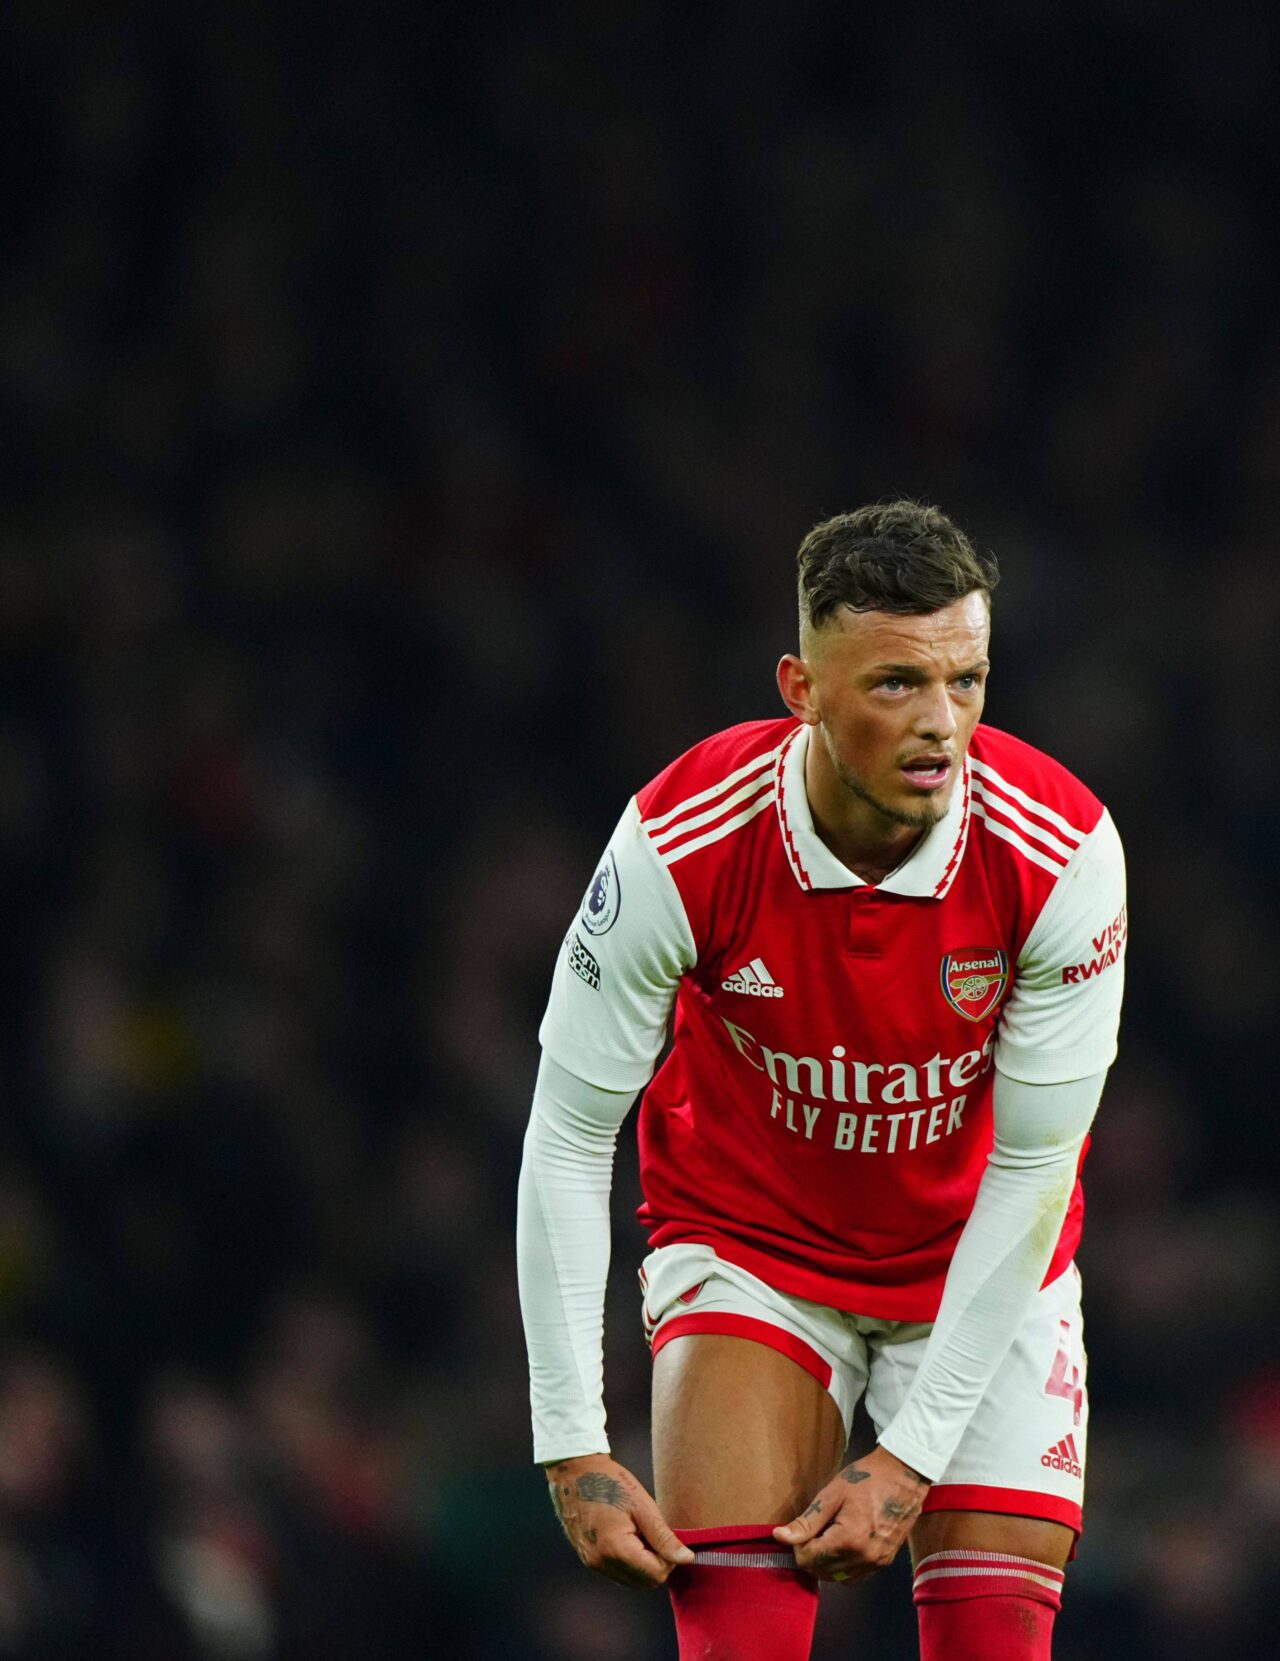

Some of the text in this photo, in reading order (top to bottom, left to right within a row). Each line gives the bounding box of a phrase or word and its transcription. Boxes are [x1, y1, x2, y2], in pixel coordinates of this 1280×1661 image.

[949, 957, 999, 973] Arsenal
[721, 979, 785, 998] adidas
[719, 1015, 996, 1105] Emirates
[770, 1086, 967, 1154] FLY BETTER
[1040, 1454, 1082, 1480] adidas
